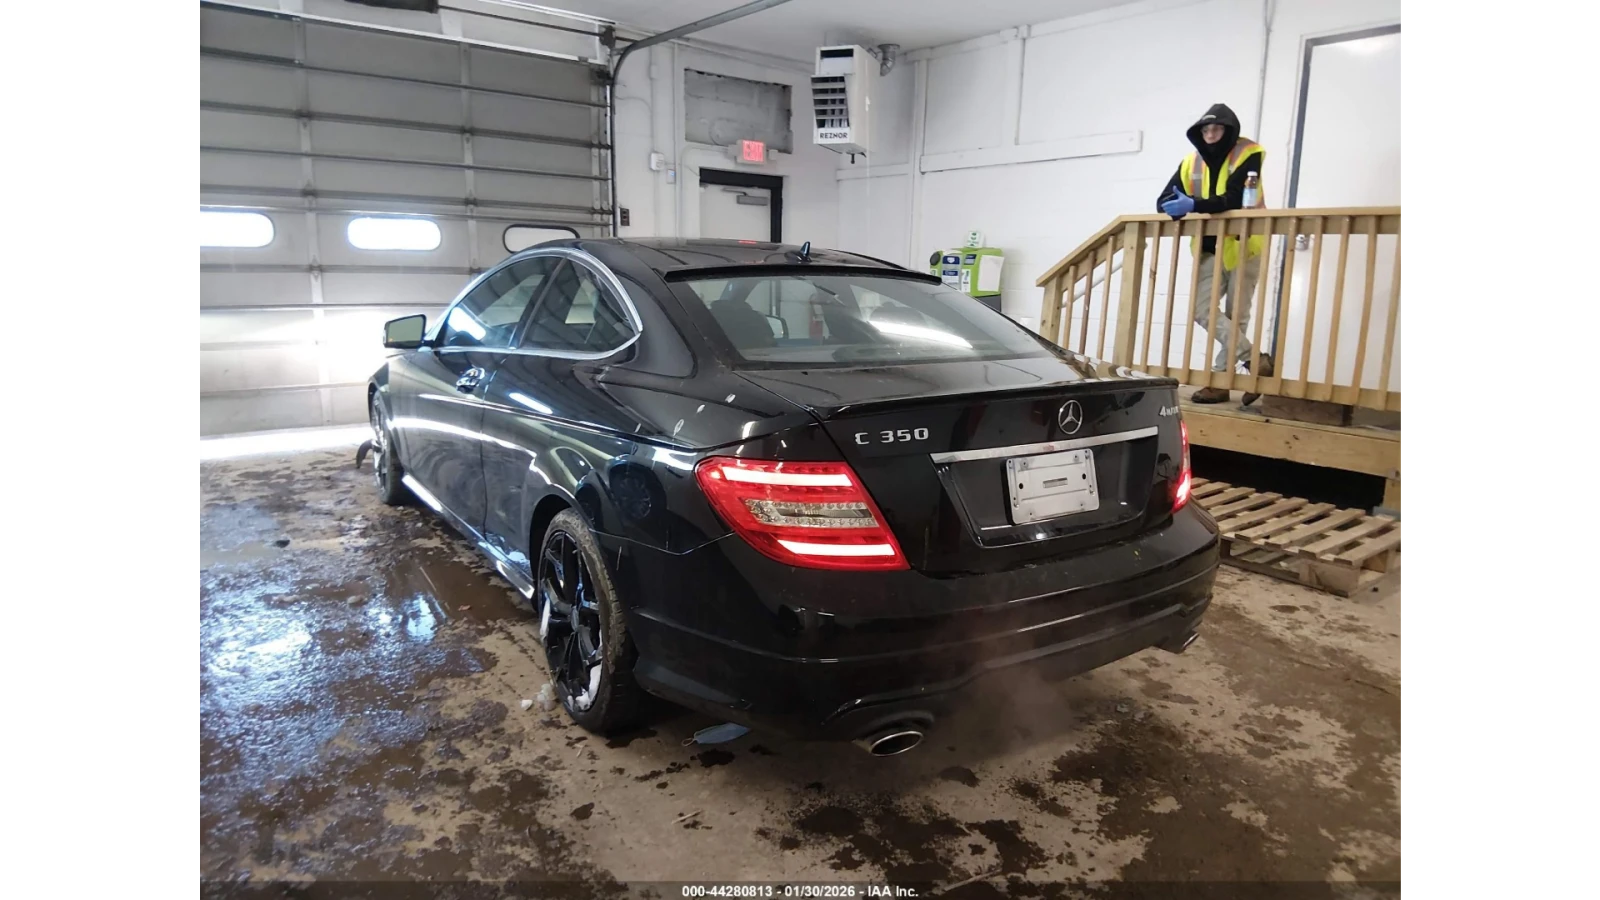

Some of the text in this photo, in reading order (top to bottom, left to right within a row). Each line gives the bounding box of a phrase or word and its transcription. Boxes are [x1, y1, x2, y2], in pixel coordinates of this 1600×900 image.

[743, 140, 764, 162] EXIT
[855, 427, 929, 445] C 350
